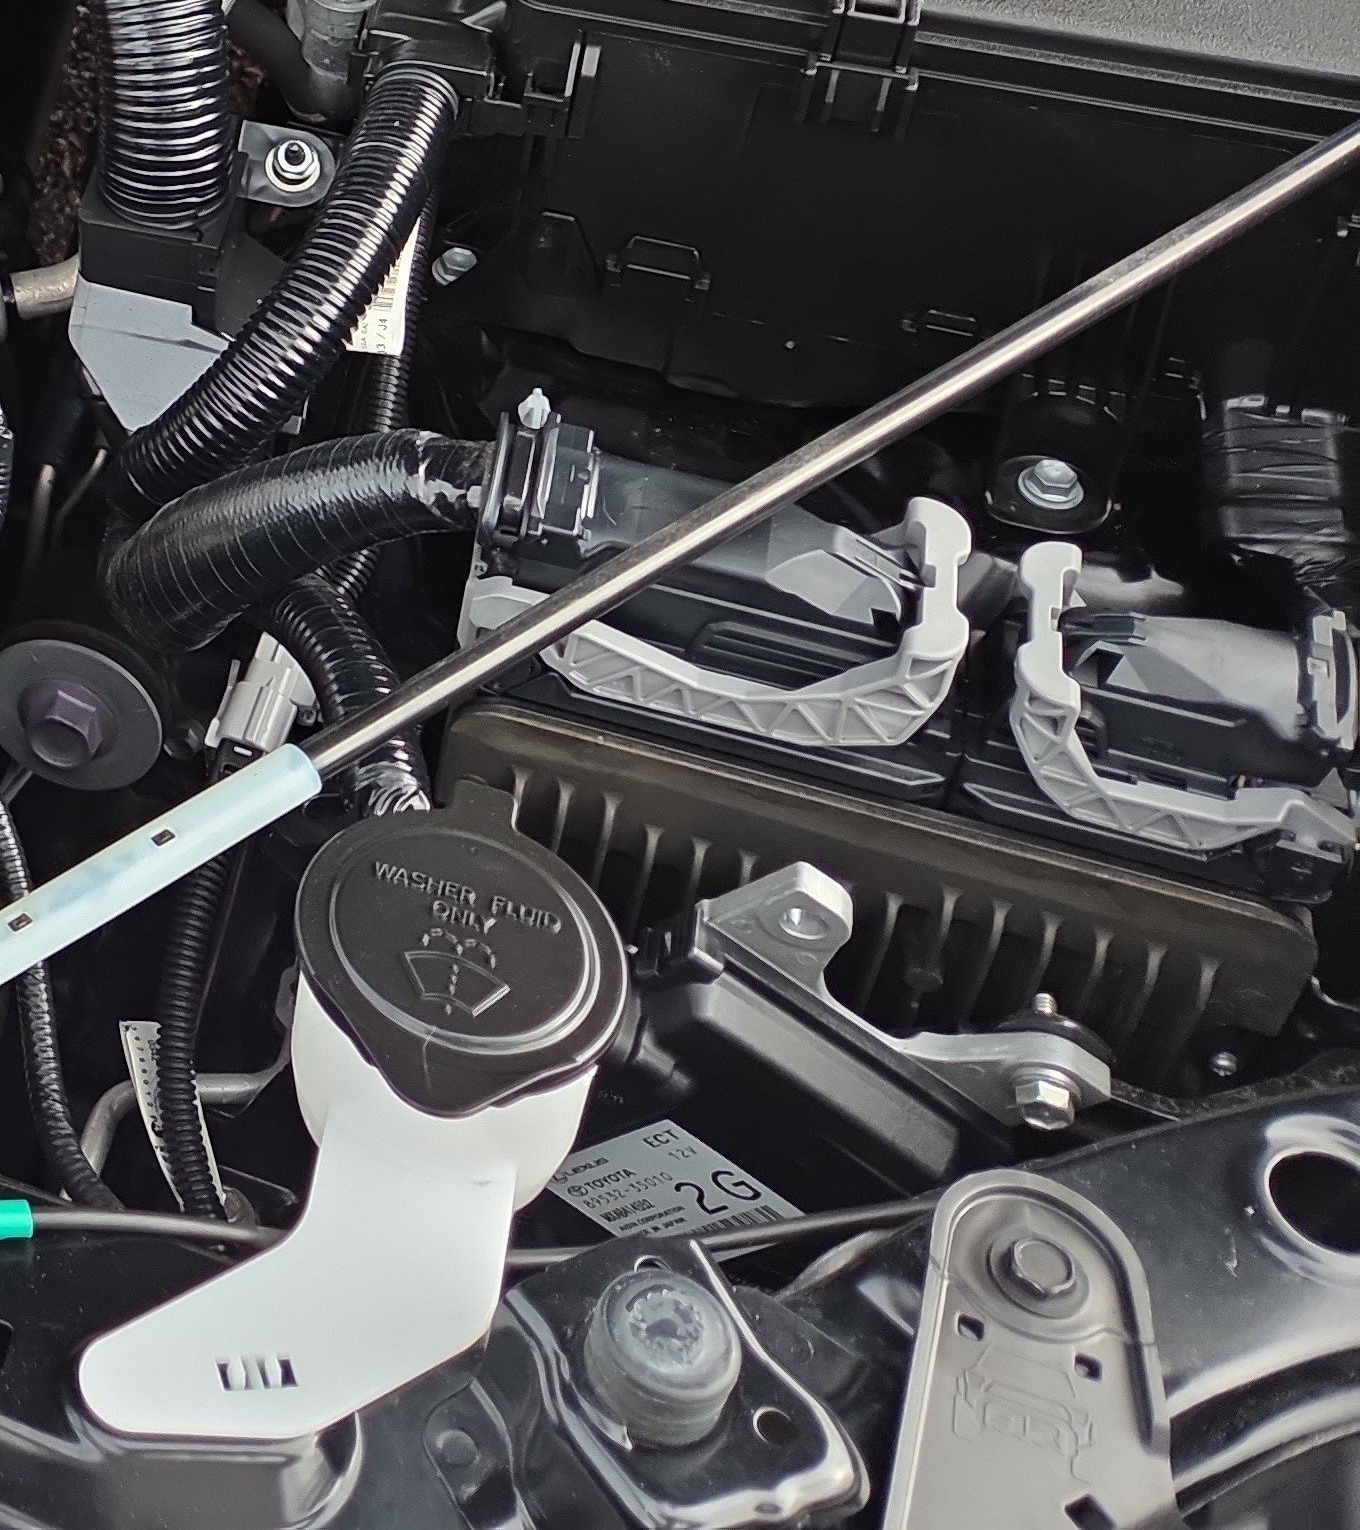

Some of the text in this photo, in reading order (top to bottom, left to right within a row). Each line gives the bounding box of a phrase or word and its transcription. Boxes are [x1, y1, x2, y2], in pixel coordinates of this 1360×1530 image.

[374, 860, 562, 935] WASHER FLUID
[432, 899, 497, 935] ONLY
[642, 1128, 680, 1149] ECT
[668, 1145, 698, 1161] 12V
[583, 1167, 638, 1191] TOYOTA
[674, 1169, 762, 1215] 2G
